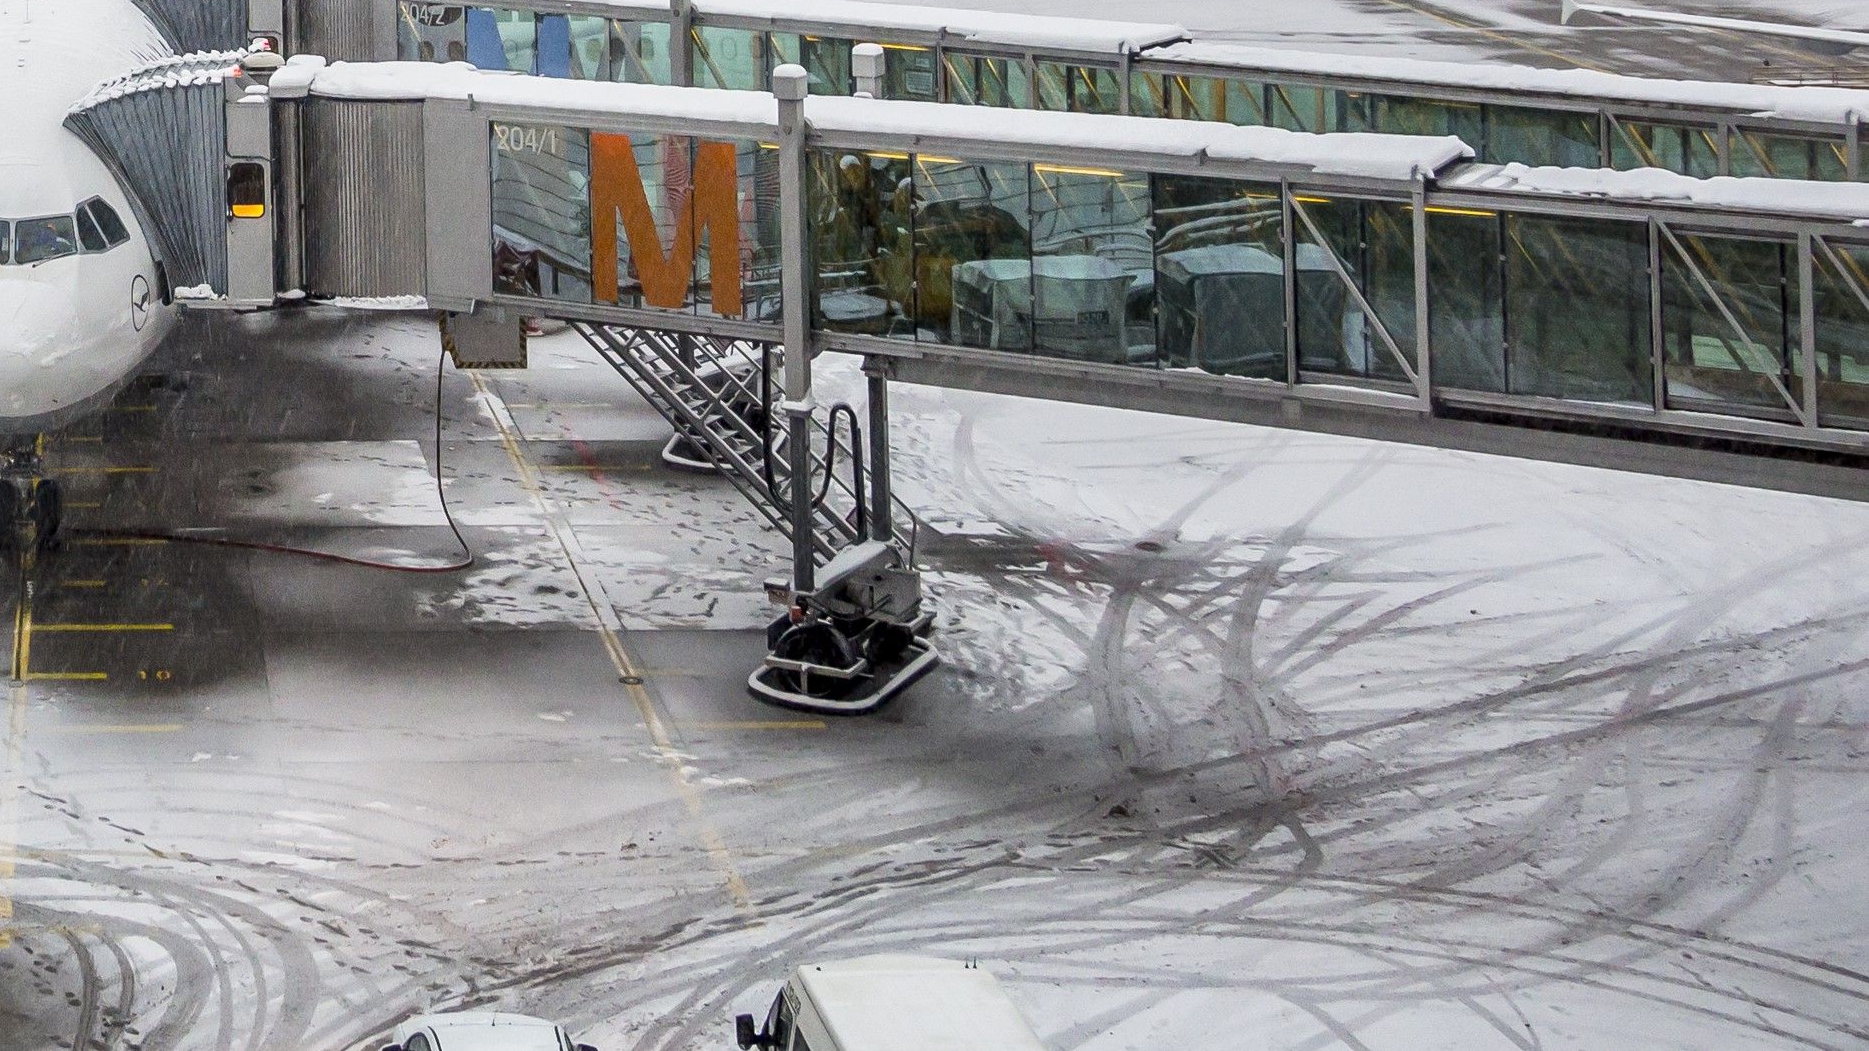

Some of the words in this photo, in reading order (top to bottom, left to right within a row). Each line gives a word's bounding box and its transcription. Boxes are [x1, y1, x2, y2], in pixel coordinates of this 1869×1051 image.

[401, 3, 445, 26] 204/2
[497, 125, 556, 156] 204/1
[592, 132, 742, 315] M
